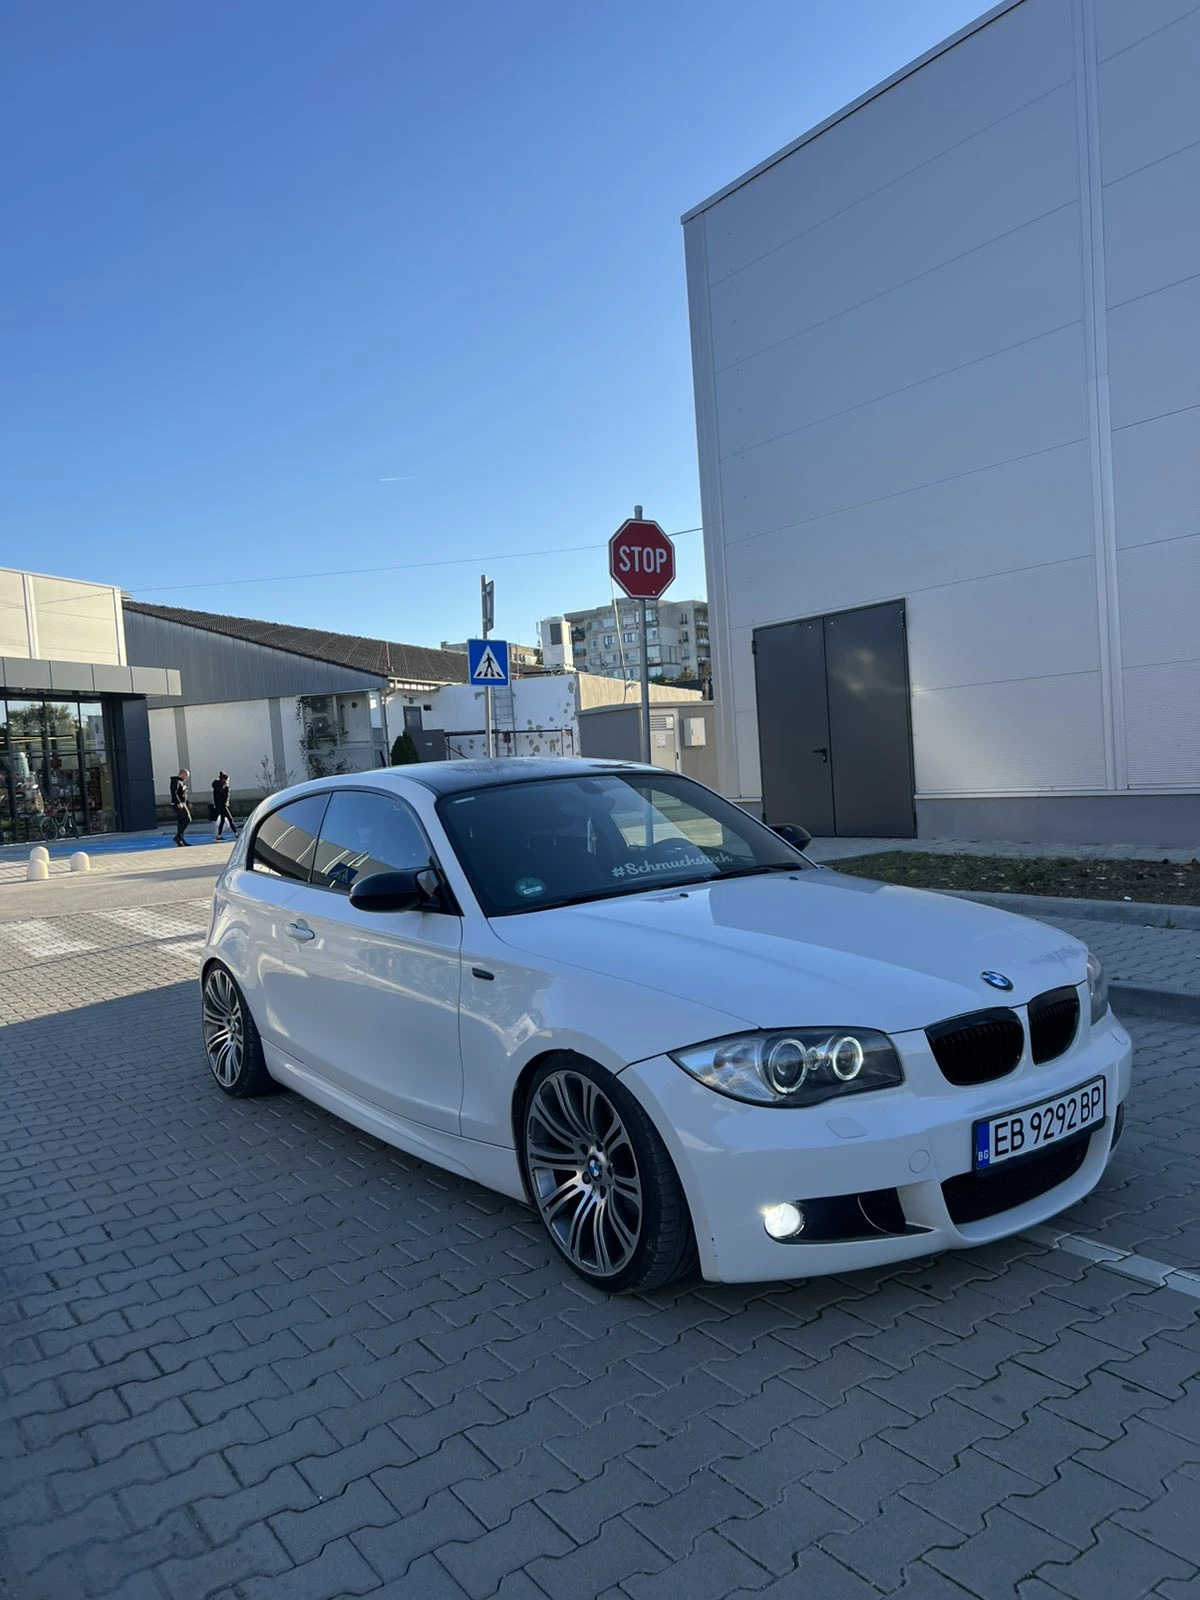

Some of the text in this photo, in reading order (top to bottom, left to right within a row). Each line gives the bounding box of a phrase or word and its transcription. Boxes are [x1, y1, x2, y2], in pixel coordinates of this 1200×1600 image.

[619, 545, 667, 574] STOP
[994, 1086, 1101, 1157] EB 9292 BP
[978, 1149, 989, 1161] BG
